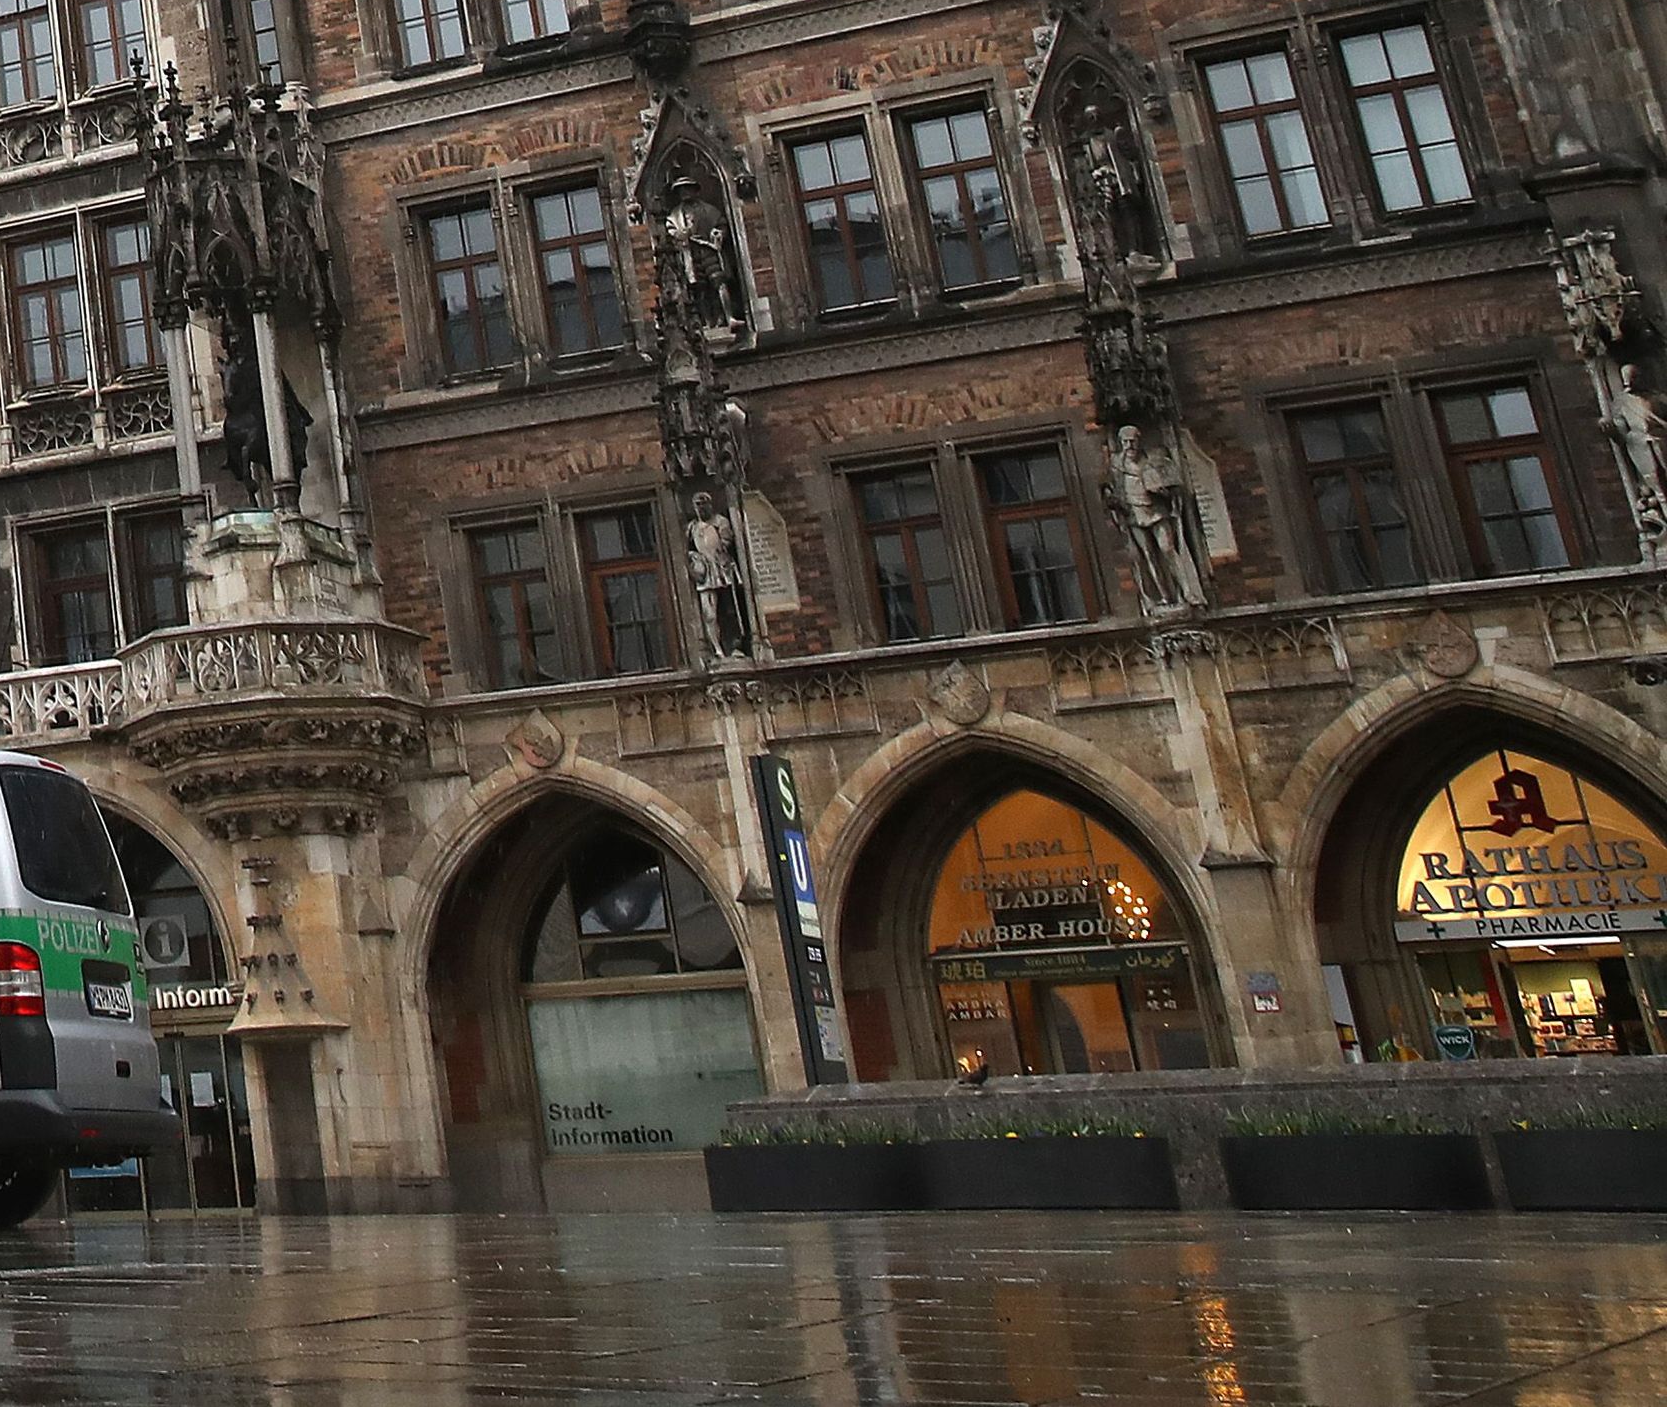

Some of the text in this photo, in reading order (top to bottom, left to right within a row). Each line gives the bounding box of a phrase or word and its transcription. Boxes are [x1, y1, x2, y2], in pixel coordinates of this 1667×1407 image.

[777, 767, 796, 821] S
[788, 838, 808, 892] U
[1418, 840, 1648, 881] RATHAUS
[993, 885, 1088, 910] LADEN
[958, 915, 1147, 946] AMBER HOUS
[1475, 913, 1622, 935] PHARMACIE
[940, 960, 987, 980] 琥珀
[1439, 1035, 1471, 1046] WICK
[548, 1101, 613, 1122] Stadt-
[551, 1125, 674, 1147] Information
